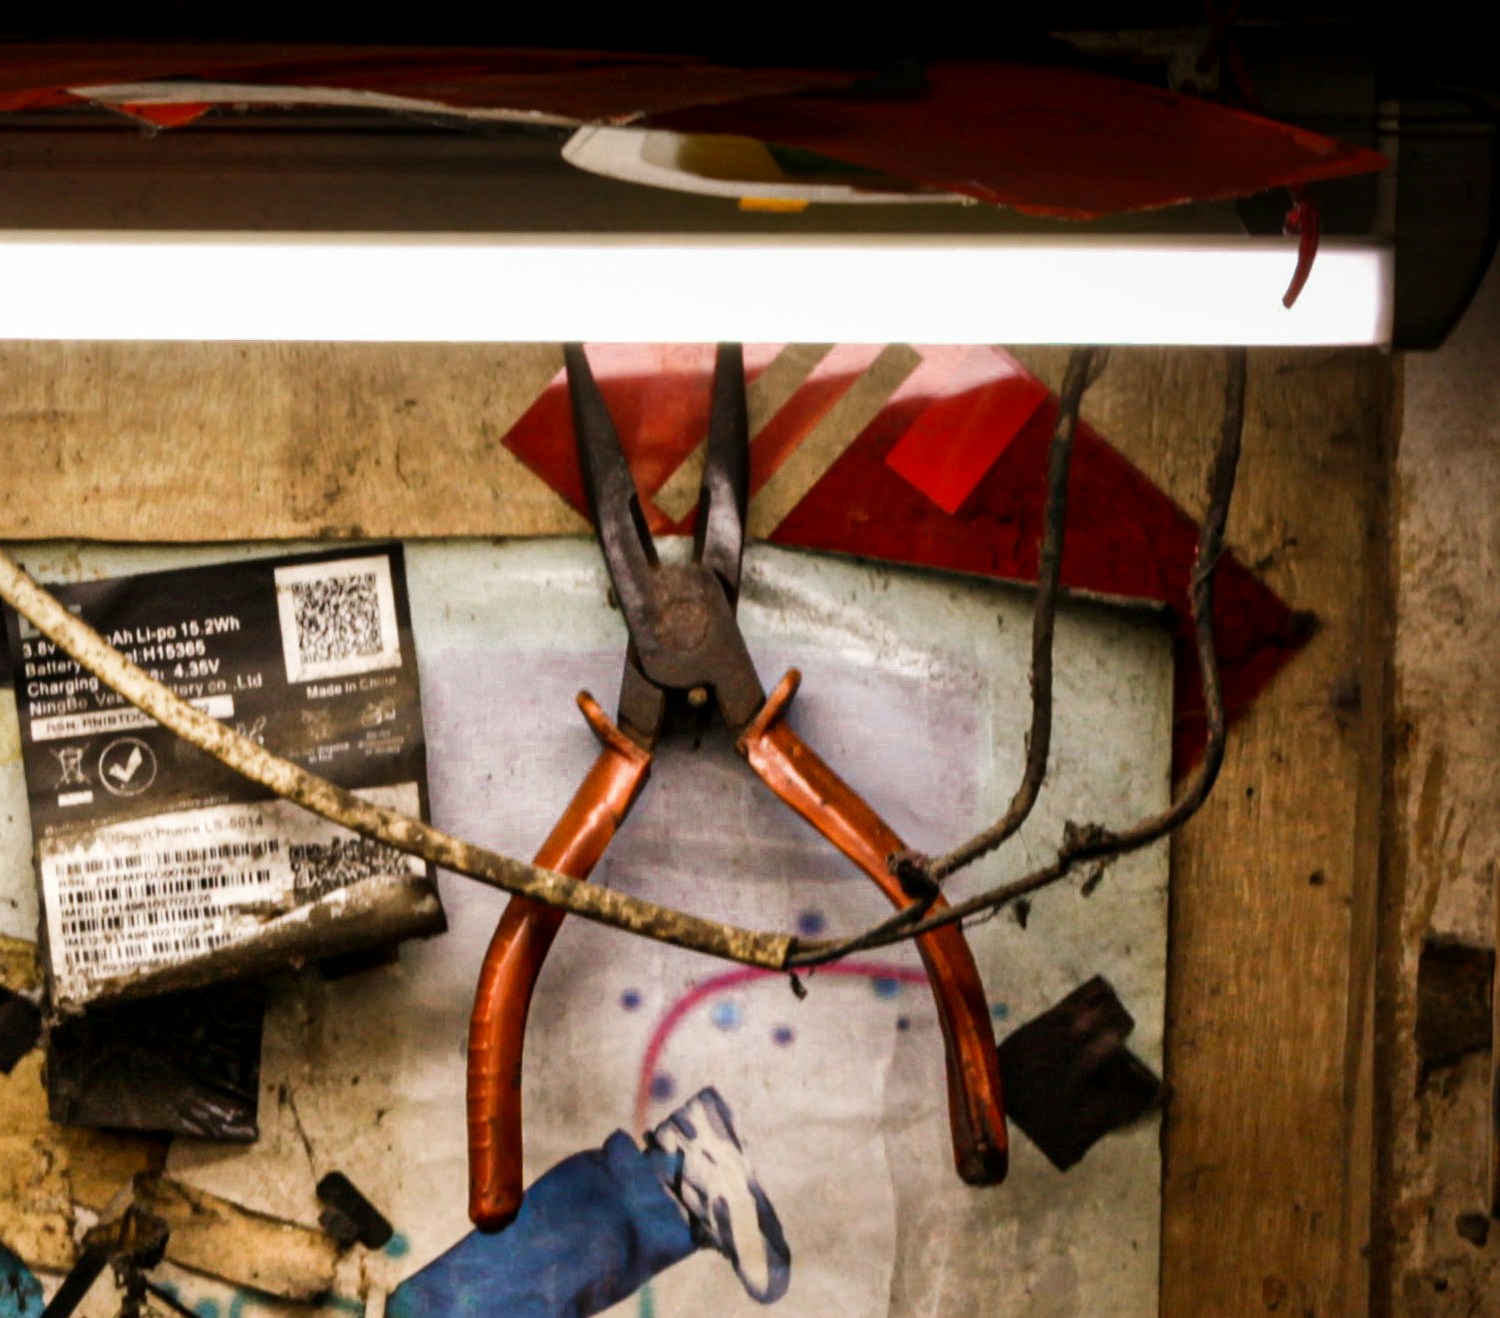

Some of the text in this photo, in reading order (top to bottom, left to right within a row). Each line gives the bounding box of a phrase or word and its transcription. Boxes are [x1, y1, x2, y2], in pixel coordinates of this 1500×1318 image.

[25, 660, 81, 679] Battery
[27, 677, 99, 699] Charging
[174, 658, 221, 679] 4.35V
[306, 682, 343, 700] Made
[345, 681, 357, 692] in
[29, 698, 88, 718] NingBo
